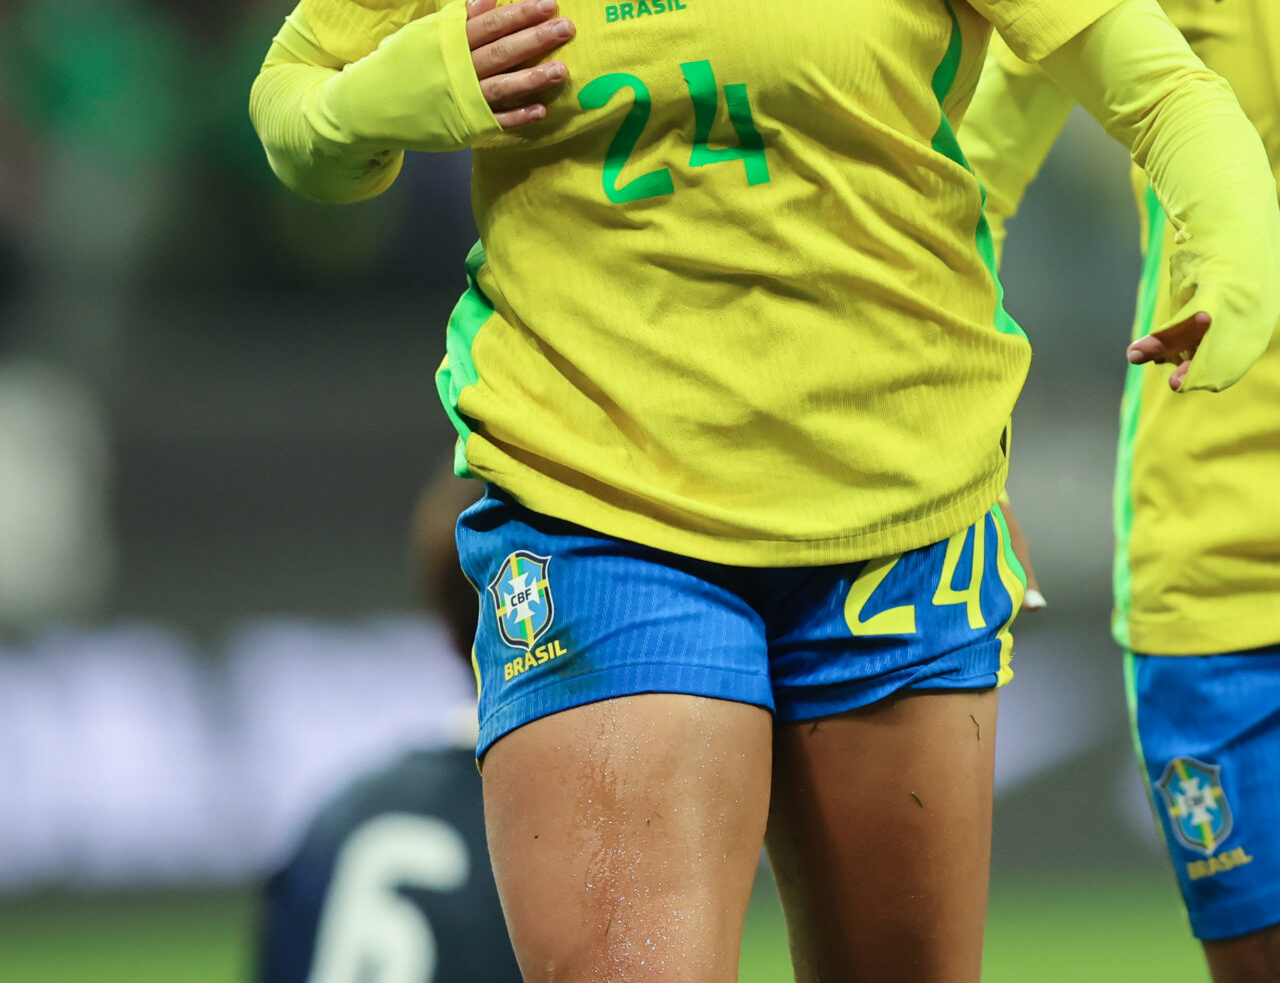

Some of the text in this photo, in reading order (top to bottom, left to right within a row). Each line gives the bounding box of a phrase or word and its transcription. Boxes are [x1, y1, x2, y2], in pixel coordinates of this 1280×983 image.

[577, 59, 770, 204] 24
[510, 588, 532, 608] CBF
[503, 639, 568, 682] BRASIL
[306, 812, 470, 983] 6
